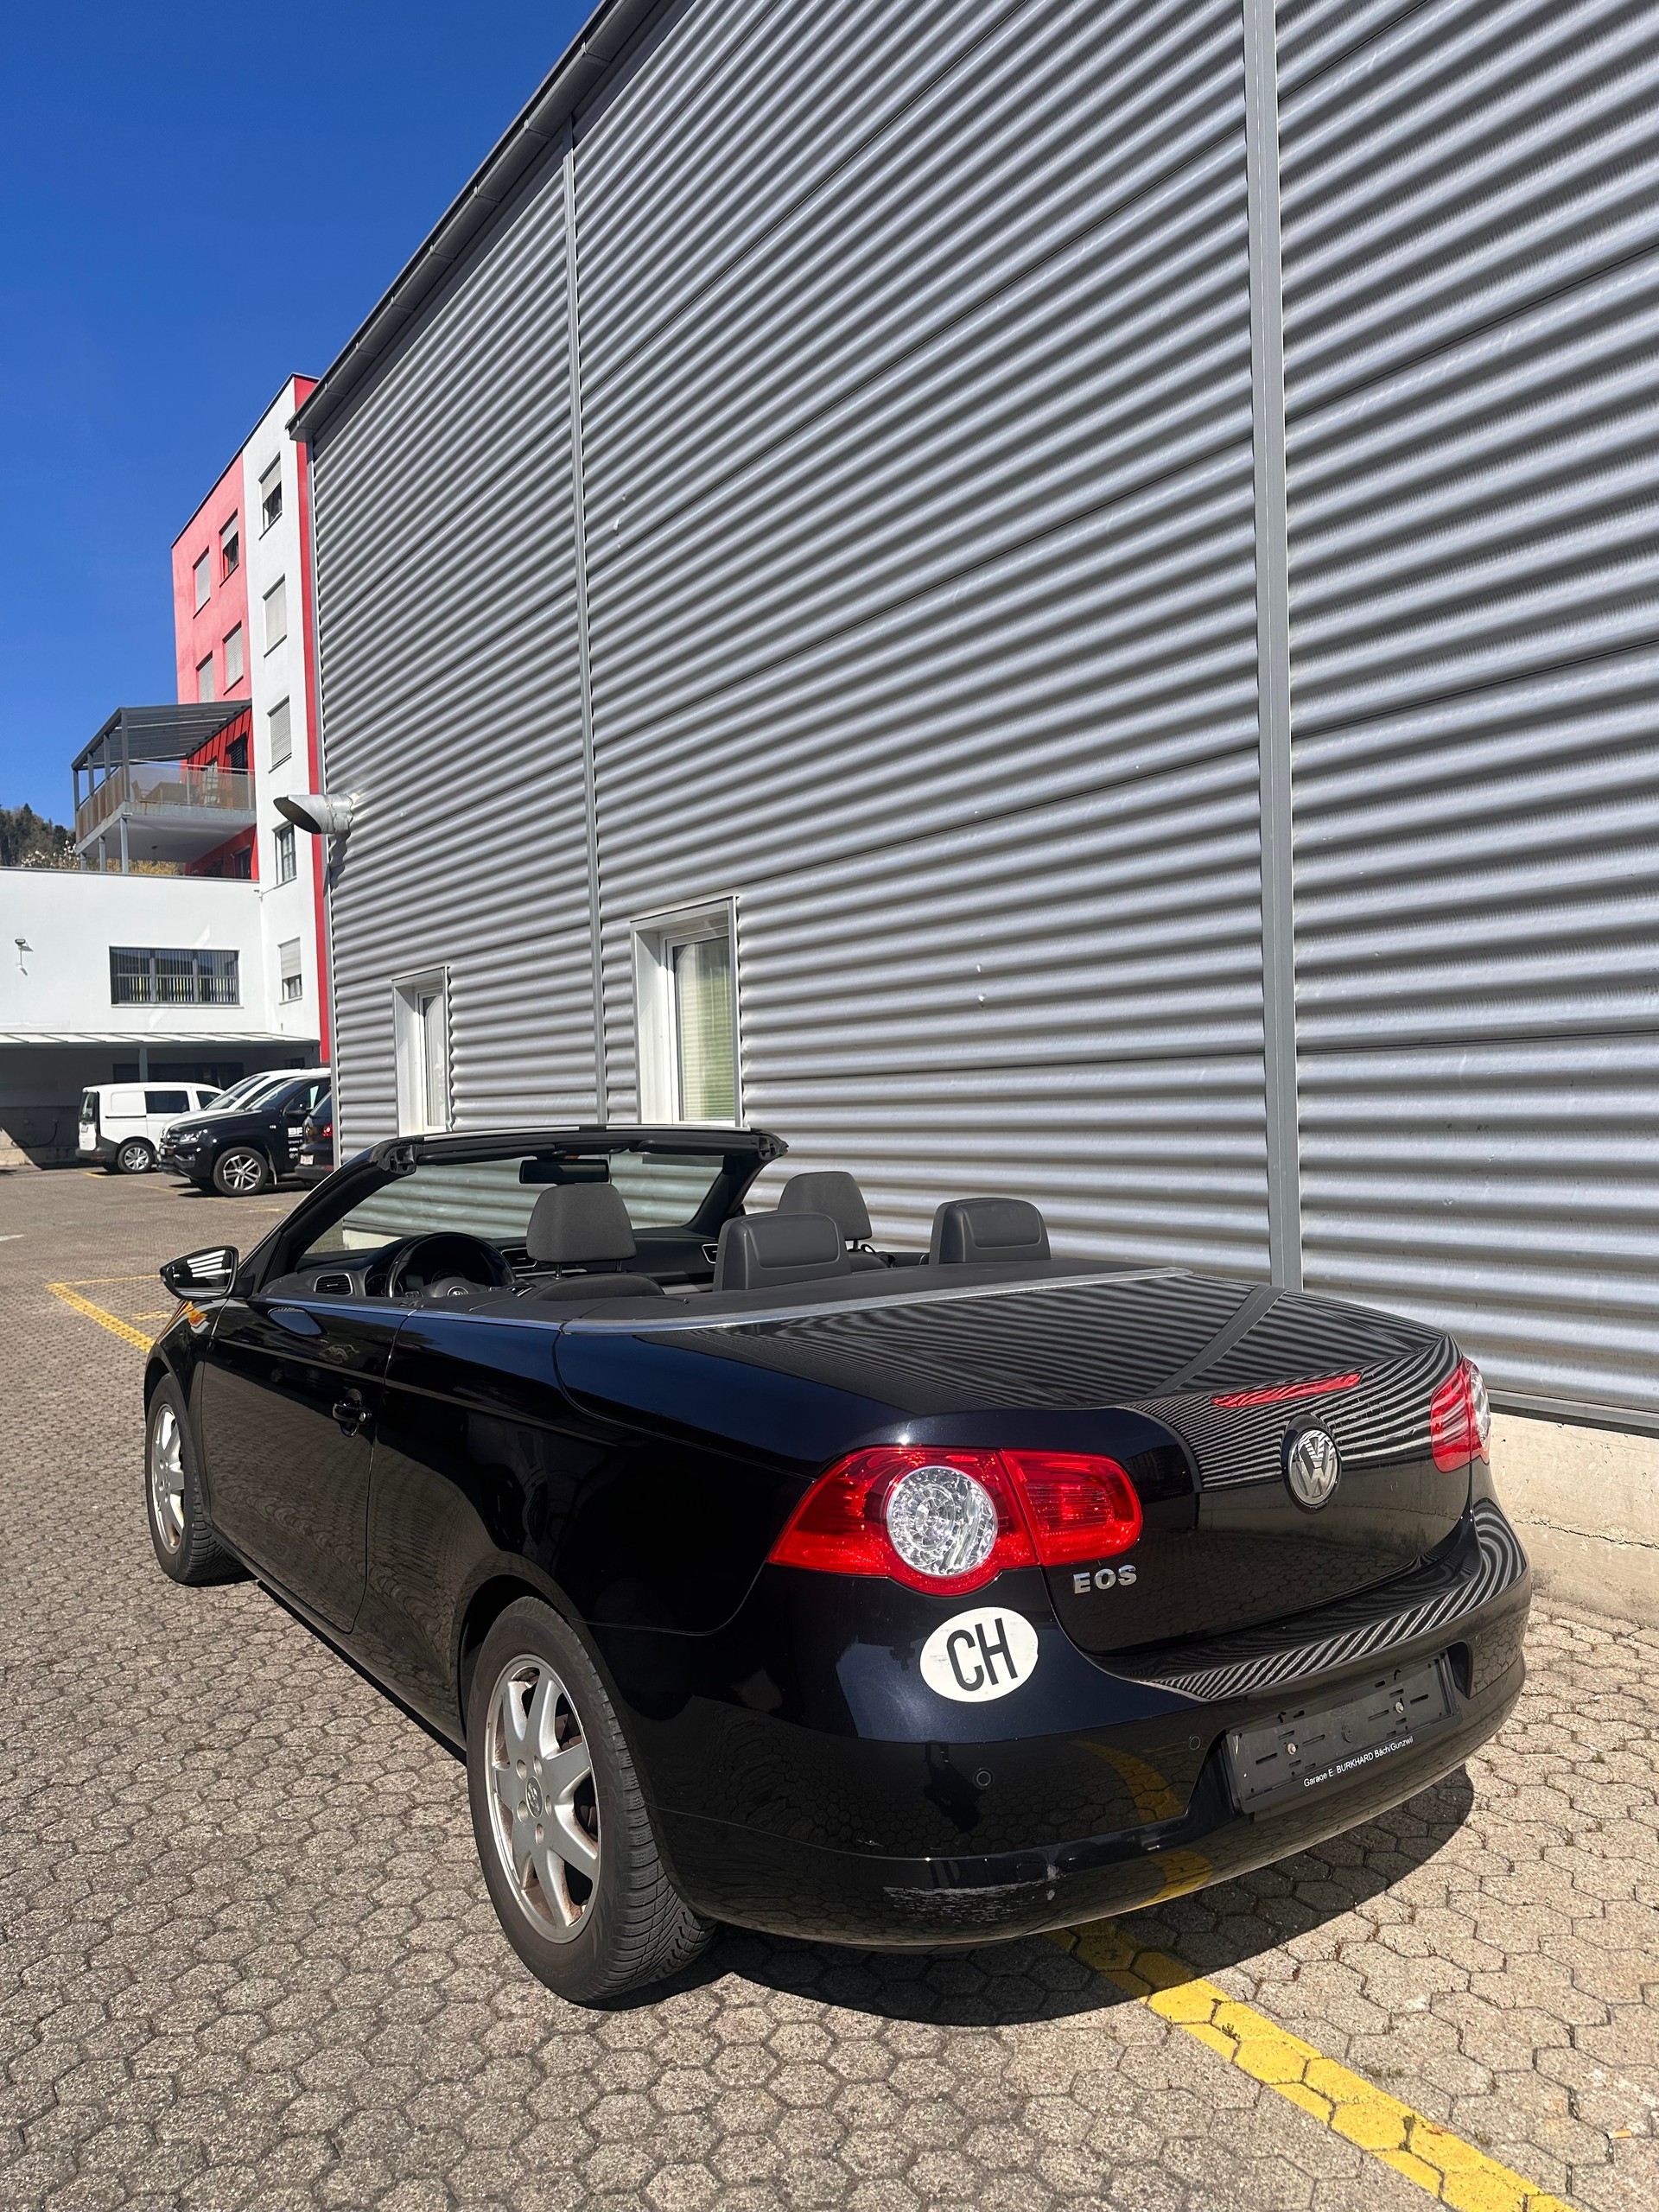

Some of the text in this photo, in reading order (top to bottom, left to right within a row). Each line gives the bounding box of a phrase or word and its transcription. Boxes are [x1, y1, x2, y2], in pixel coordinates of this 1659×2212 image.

[1072, 1564, 1138, 1594] EOS
[946, 1618, 1018, 1692] CH
[1303, 1772, 1327, 1787] Garage
[1336, 1751, 1374, 1774] BURKHARD
